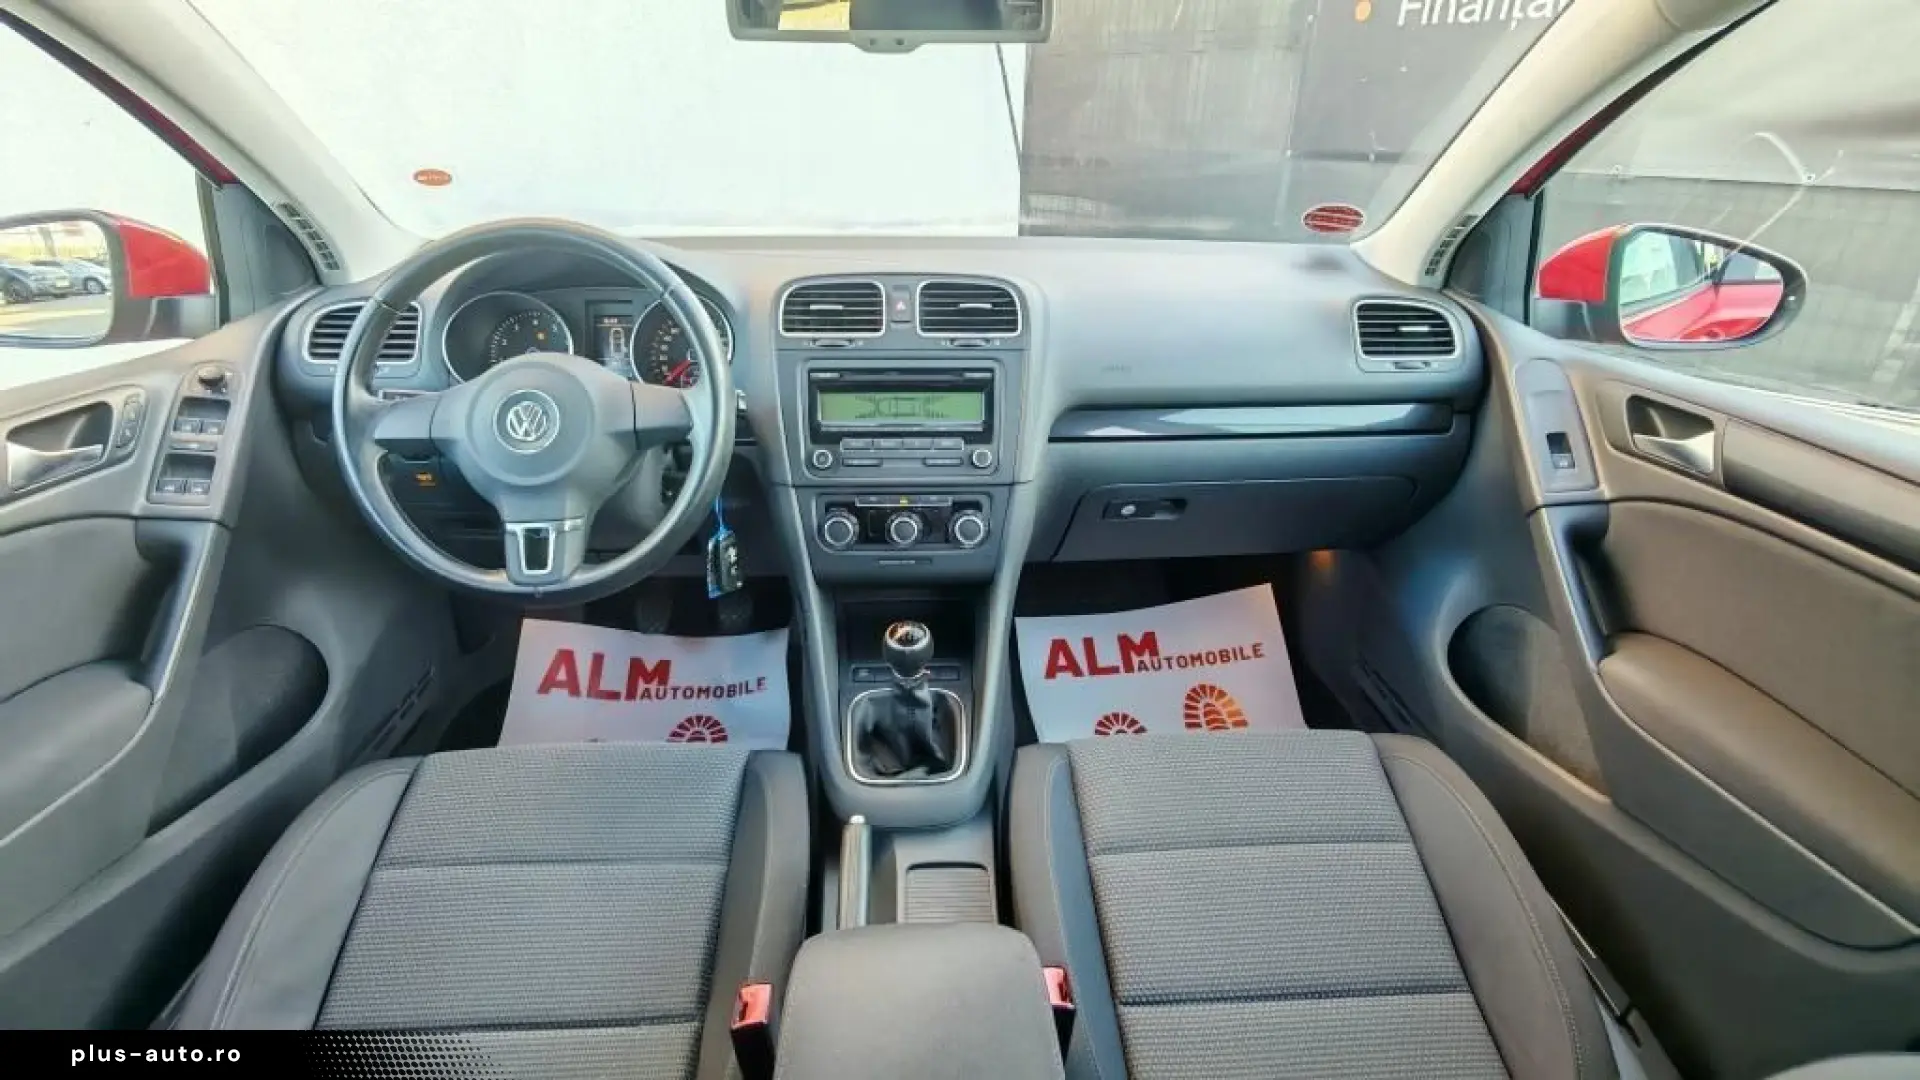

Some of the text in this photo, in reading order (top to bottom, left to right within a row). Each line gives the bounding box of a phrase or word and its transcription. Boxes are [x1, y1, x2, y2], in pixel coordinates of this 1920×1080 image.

[537, 648, 767, 701] ALM AUTOMOBILE
[1044, 631, 1265, 679] ALM AUTOMOBILE
